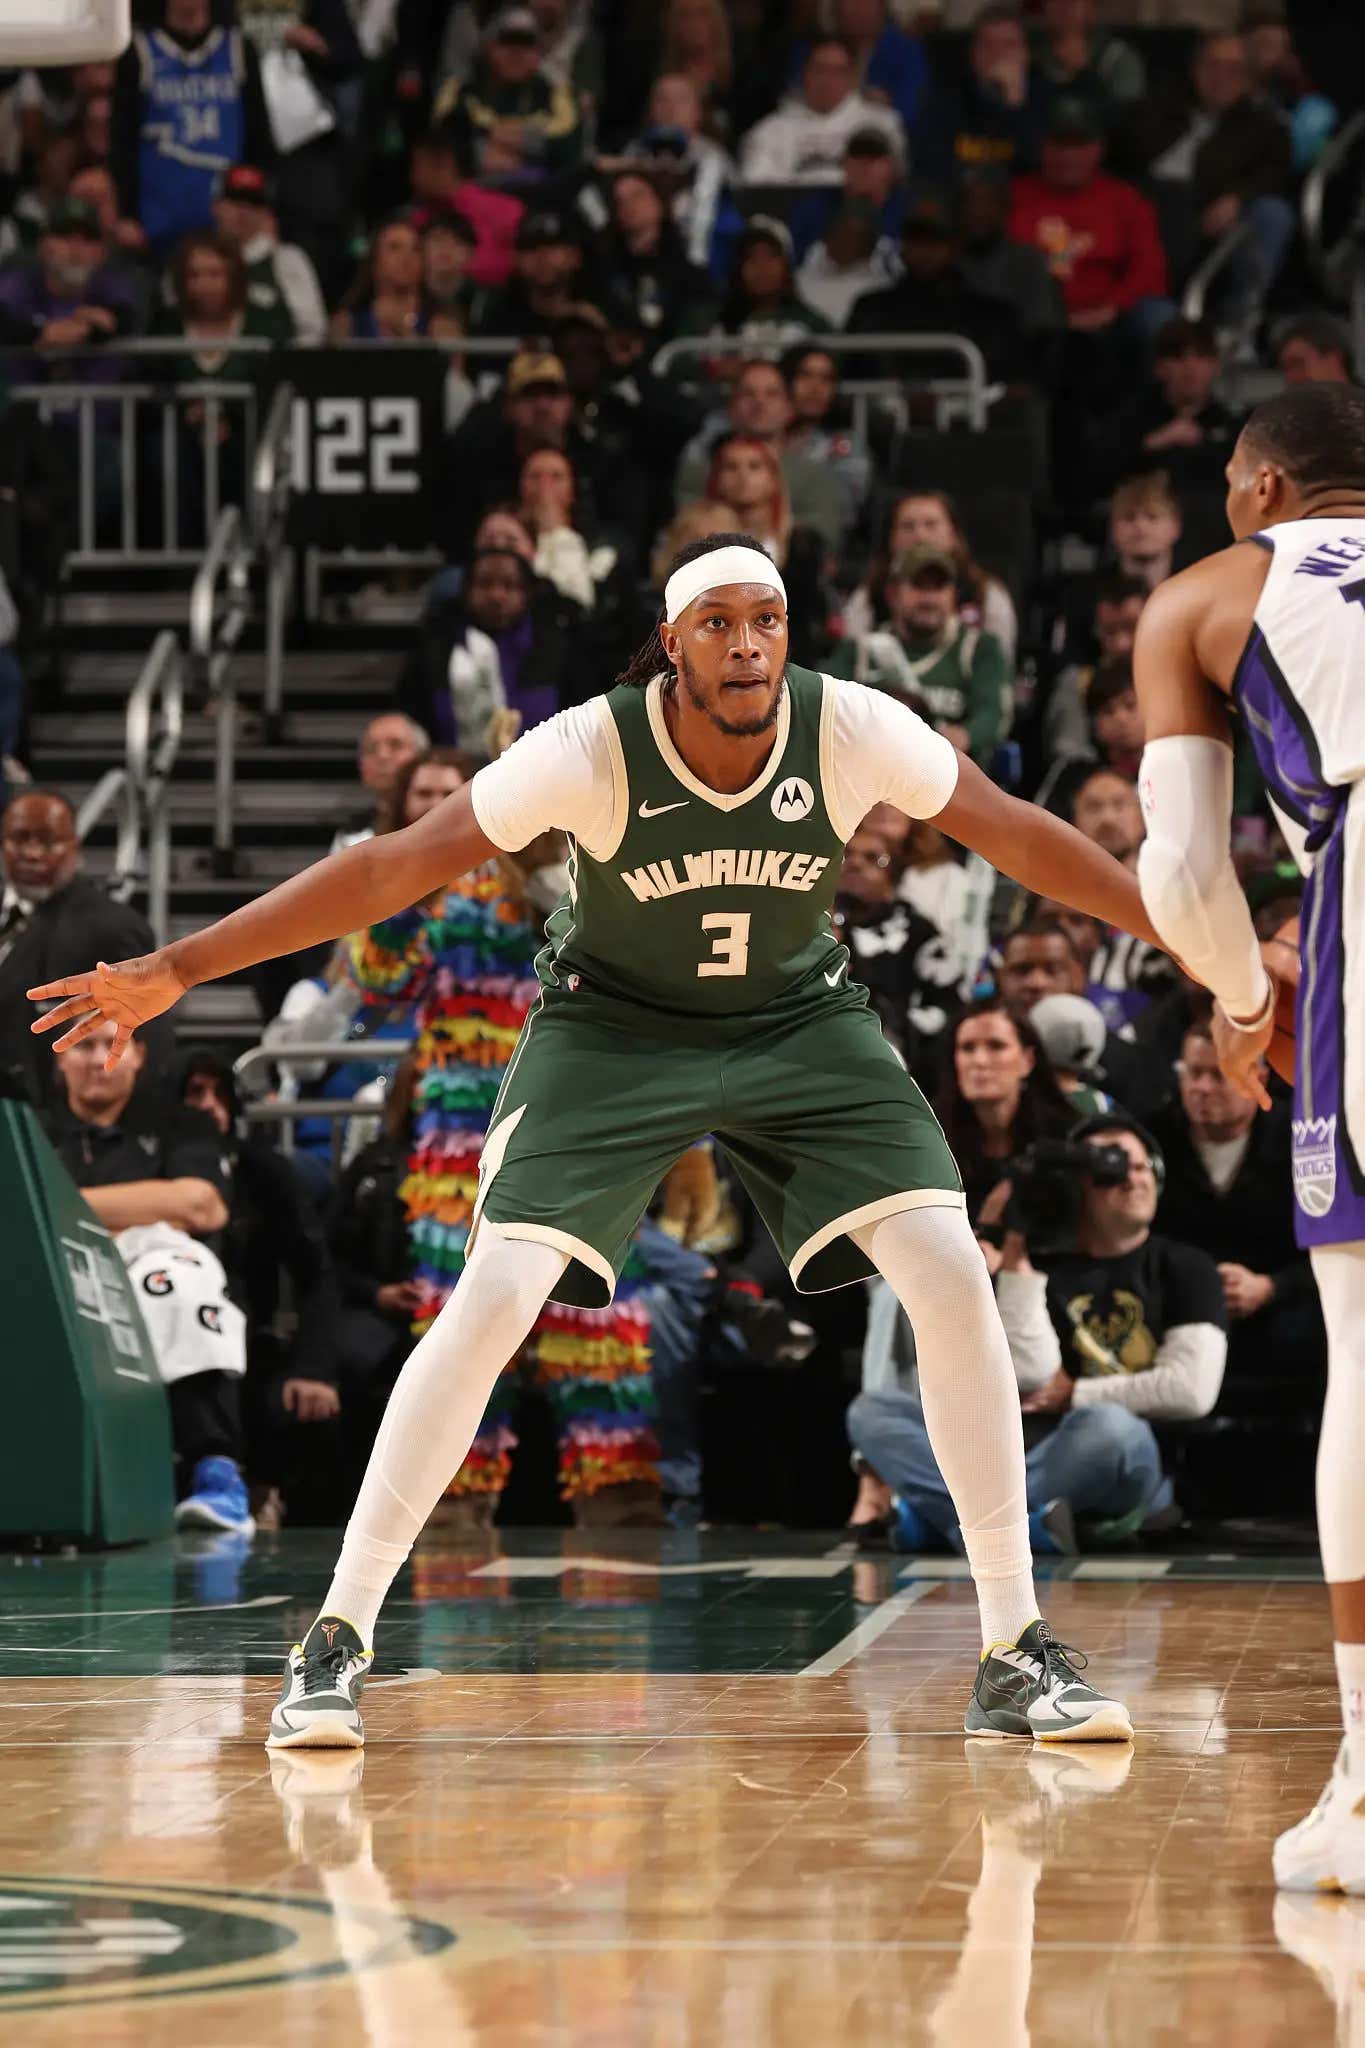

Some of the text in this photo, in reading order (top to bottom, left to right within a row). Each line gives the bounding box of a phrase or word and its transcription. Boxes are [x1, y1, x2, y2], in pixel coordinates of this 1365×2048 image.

[290, 397, 420, 493] 122
[620, 849, 831, 903] MILWAUKEE
[697, 912, 751, 978] 3
